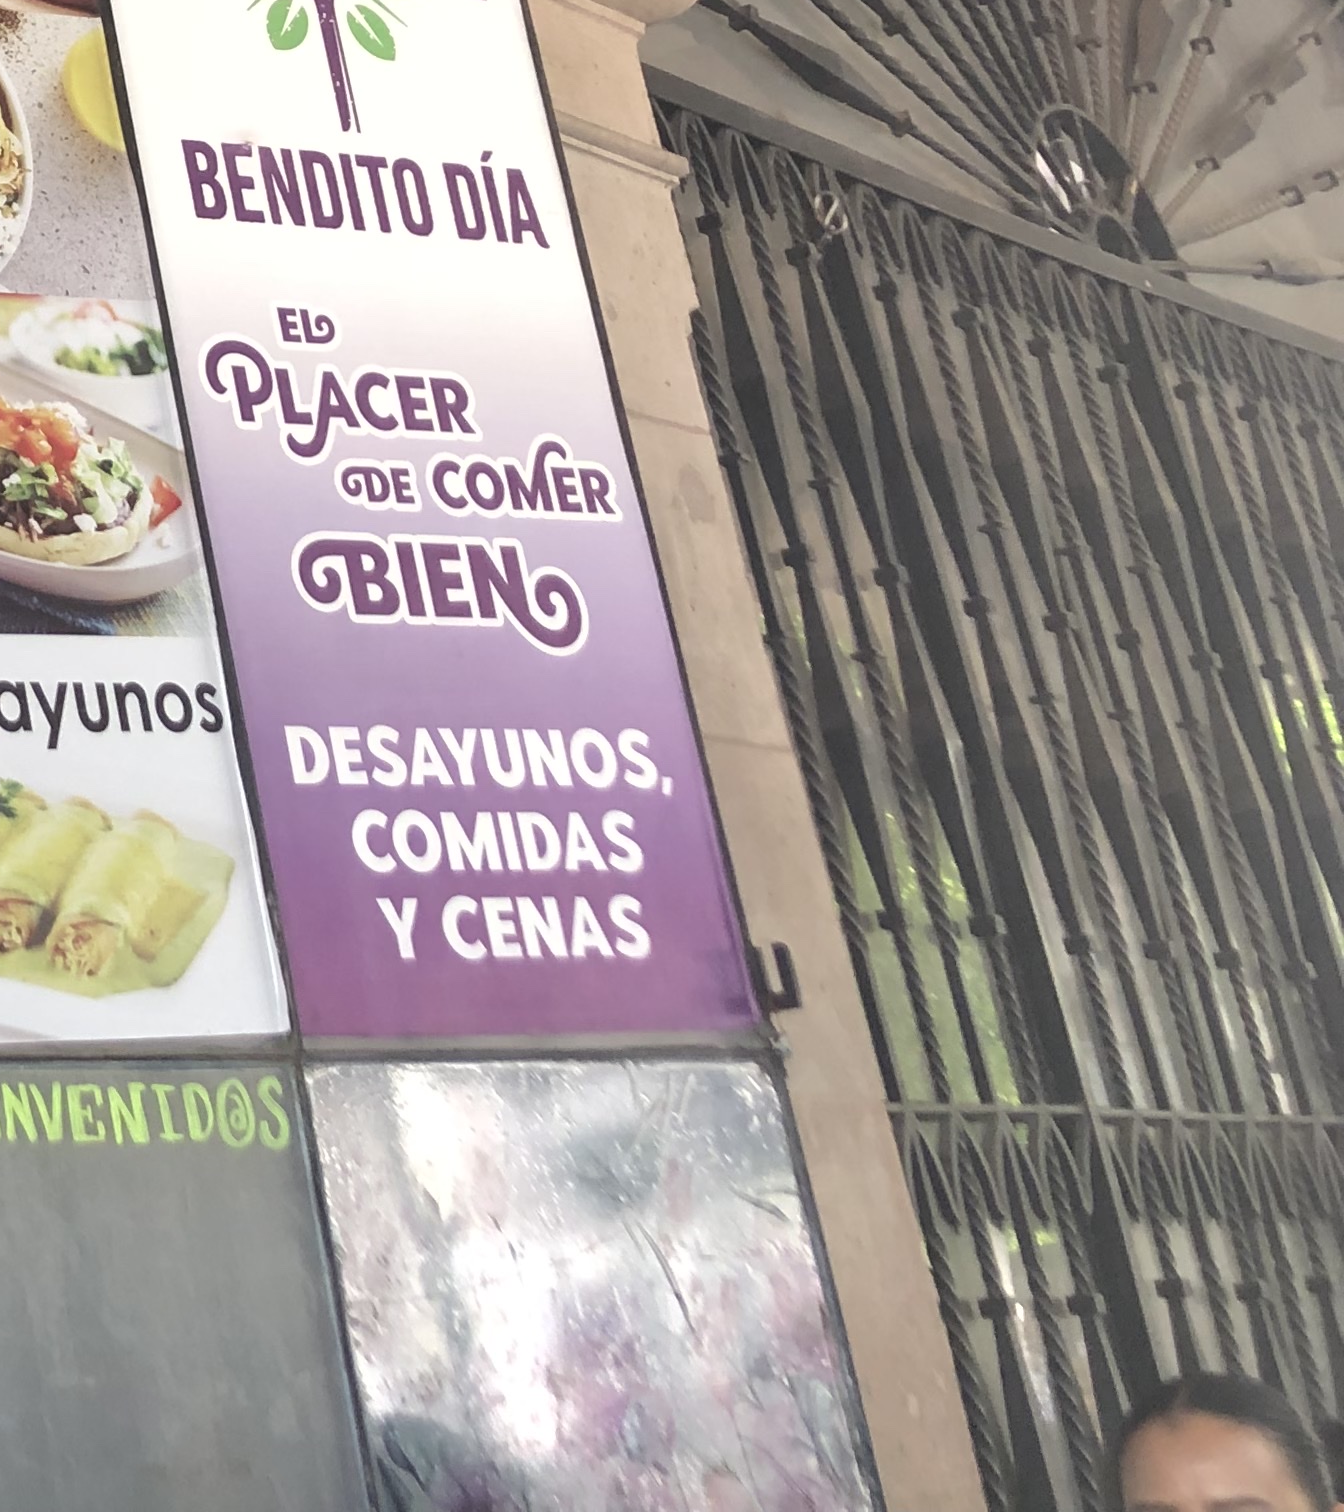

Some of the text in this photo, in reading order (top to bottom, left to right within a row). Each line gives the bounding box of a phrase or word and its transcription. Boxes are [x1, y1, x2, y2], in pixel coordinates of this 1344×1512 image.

[181, 138, 550, 249] BENDITO DÍA
[277, 307, 335, 344] EL
[205, 340, 476, 457] PLACER
[342, 441, 617, 515] DE COMER
[299, 538, 584, 649] BIEN
[284, 725, 673, 796] DESAYUNOS,
[351, 808, 645, 873] COMIDAS
[376, 894, 652, 959] Y CENAS
